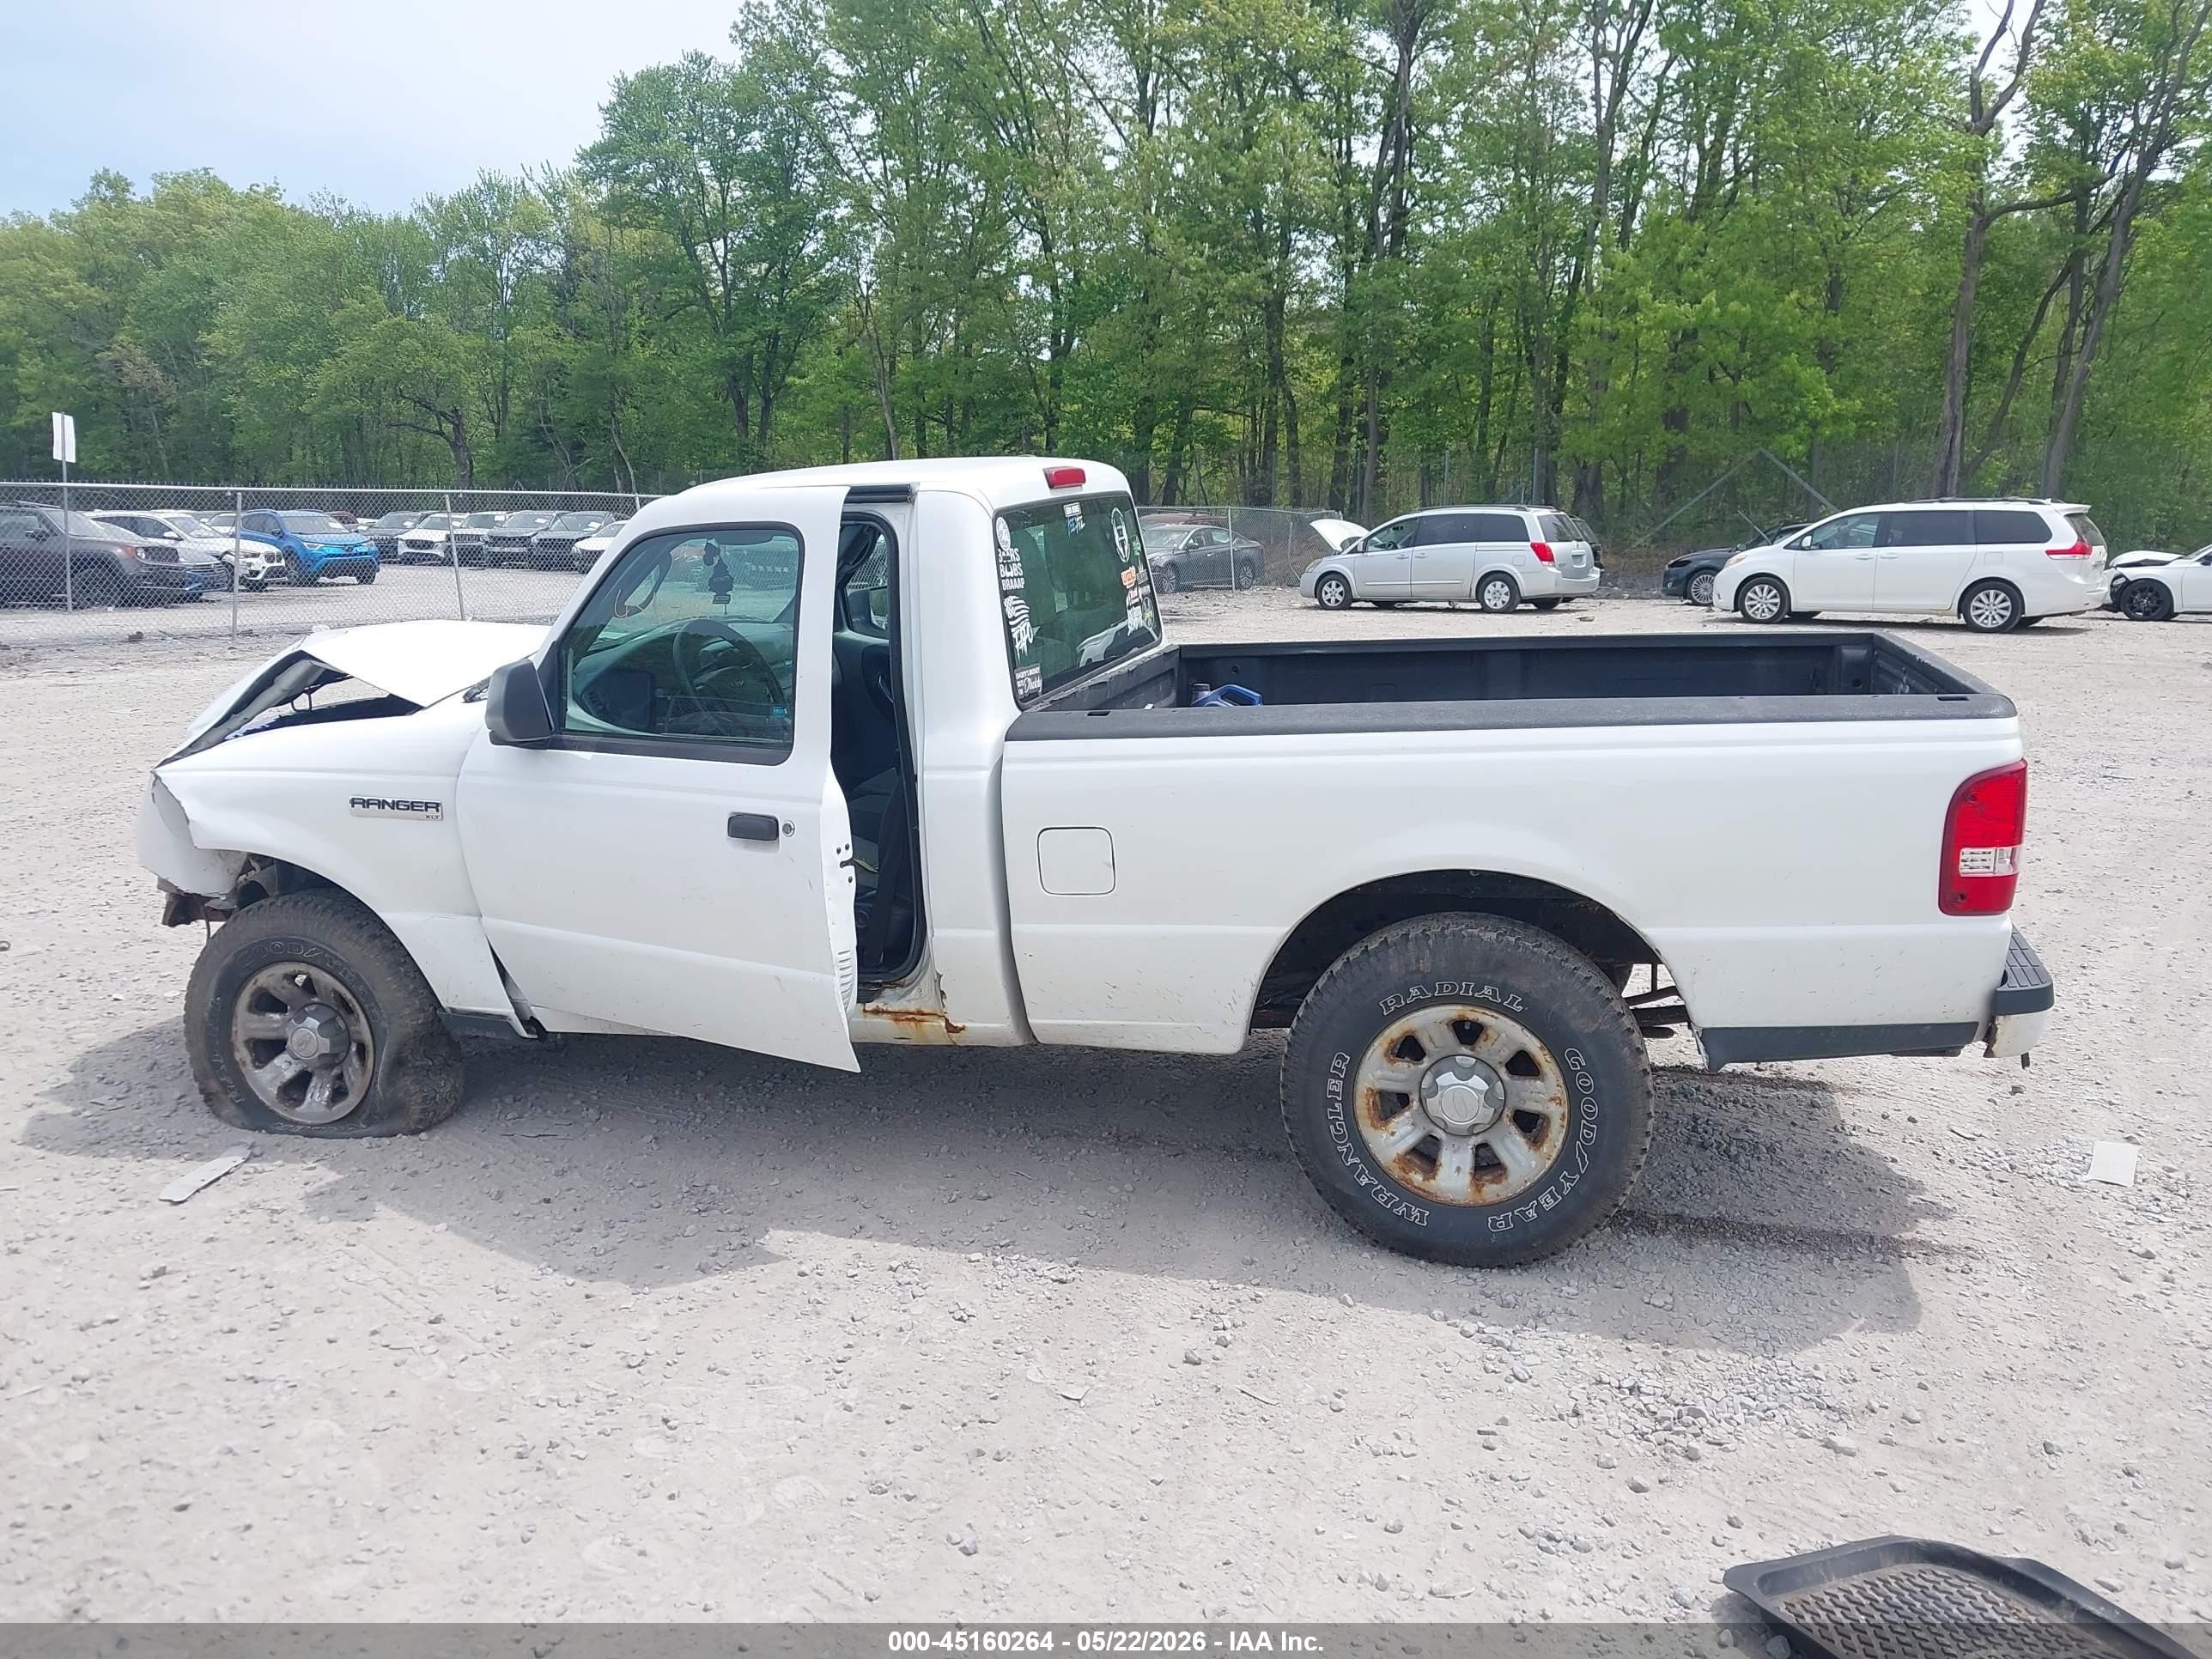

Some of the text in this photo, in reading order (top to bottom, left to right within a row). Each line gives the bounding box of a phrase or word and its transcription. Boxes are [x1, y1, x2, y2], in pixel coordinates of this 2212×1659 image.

[1001, 578, 1024, 591] BRAAAP
[349, 797, 441, 813] RANGER
[1378, 981, 1526, 1016] RADIAL
[1326, 1051, 1430, 1227] WRANGLER
